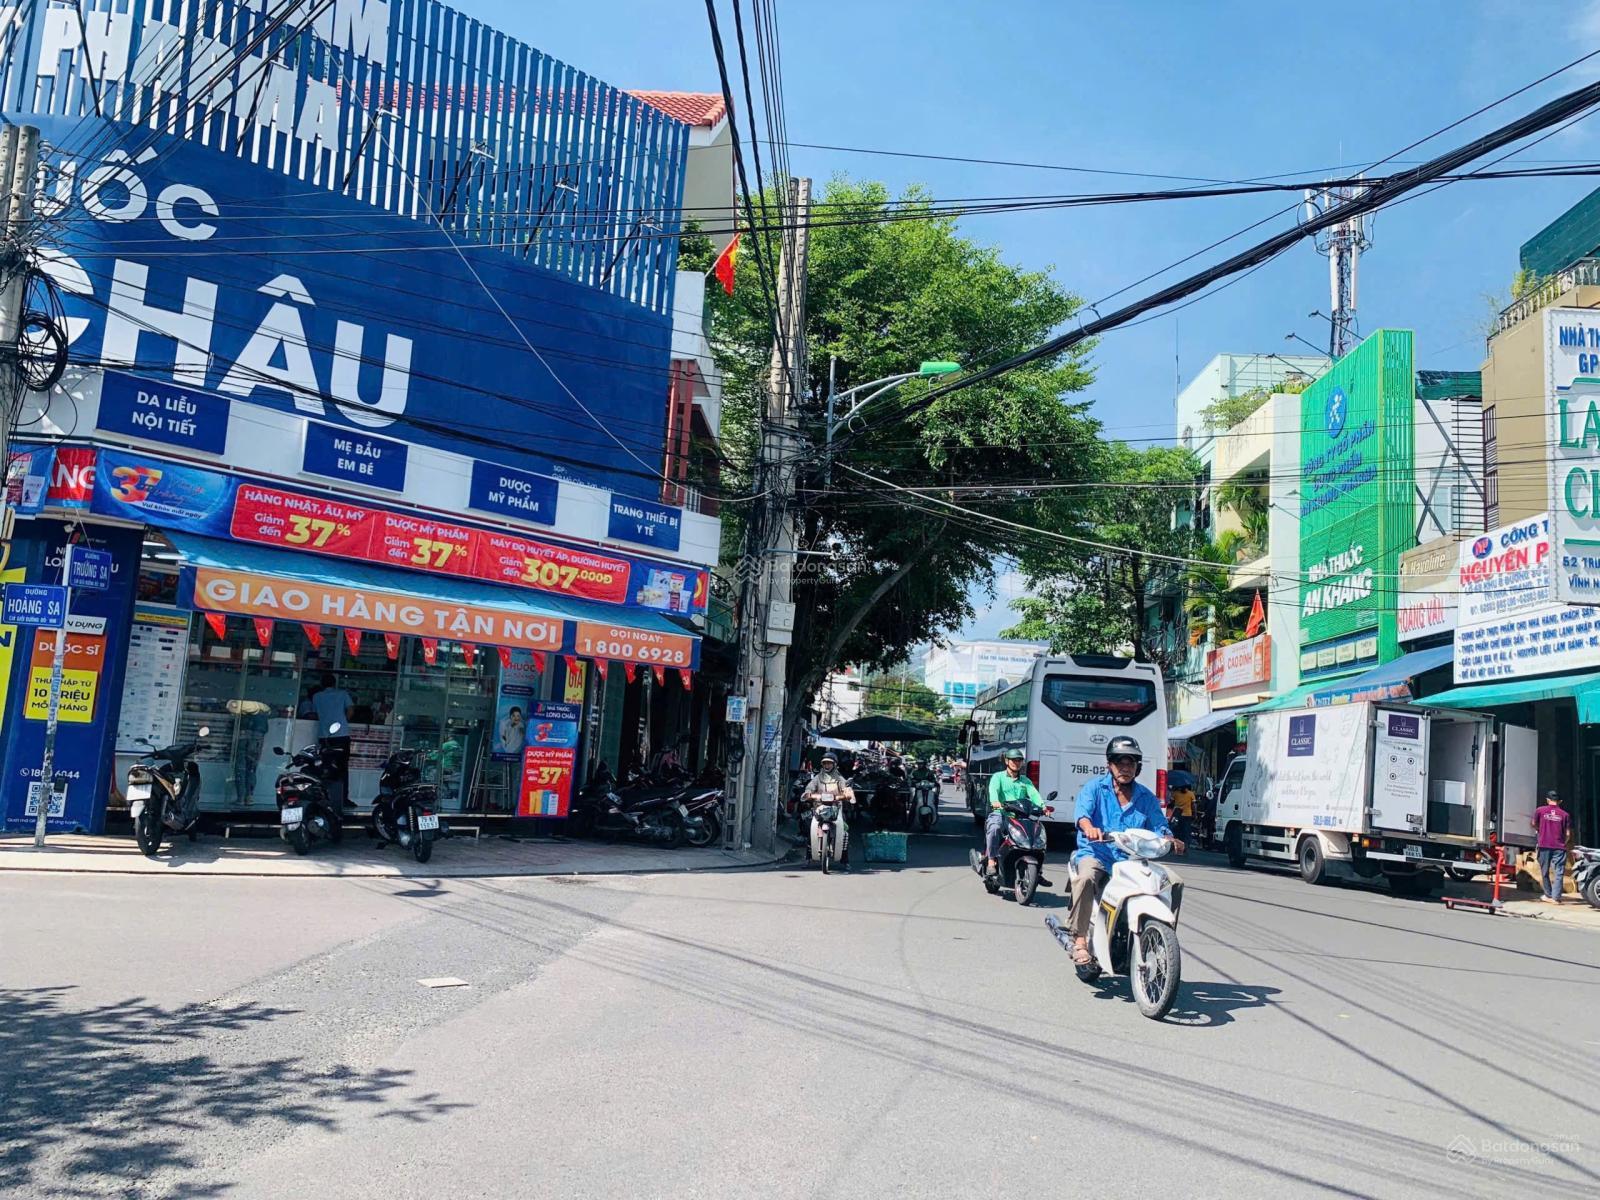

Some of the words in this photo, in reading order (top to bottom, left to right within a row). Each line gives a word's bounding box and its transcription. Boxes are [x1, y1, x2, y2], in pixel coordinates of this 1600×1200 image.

[1560, 322, 1585, 347] NHÀ
[137, 391, 160, 408] DA
[166, 391, 197, 416] LIỄU
[132, 412, 166, 432] NỘI
[168, 415, 197, 437] TIẾT
[334, 438, 351, 455] MẸ
[356, 440, 382, 460] BẦU
[337, 458, 355, 472] EM
[359, 459, 374, 475] BÉ
[111, 465, 163, 502] 37
[500, 477, 532, 494] DƯỢC
[245, 489, 282, 507] HÀNG
[285, 495, 320, 515] NHẬT,
[346, 507, 365, 521] MỸ
[489, 489, 504, 503] MỸ
[507, 492, 539, 512] PHẨM
[613, 503, 643, 520] TRANG
[646, 509, 668, 526] THIẾT
[669, 516, 679, 529] BỊ
[259, 524, 281, 538] đến
[386, 518, 417, 531] DƯỢC
[420, 522, 436, 535] MỸ
[637, 524, 642, 535] Y
[644, 524, 655, 537] TẾ
[490, 538, 510, 549] MÁY
[1500, 522, 1538, 549] CÔNG
[1329, 541, 1364, 575] THUỐC
[1563, 556, 1578, 567] 52
[73, 560, 98, 579] TRƯỜNG
[100, 565, 108, 580] SA
[1301, 587, 1321, 618] AN
[1322, 567, 1373, 610] KHANG
[8, 595, 42, 615] HOÀNG
[47, 600, 60, 616] SA
[206, 578, 311, 611] GIAO
[322, 591, 424, 626] HÀNG
[434, 604, 494, 637] TẬN
[503, 618, 557, 643] NƠI
[75, 620, 103, 631] DỤNG
[610, 628, 632, 642] GỌI
[634, 630, 664, 643] NGAY:
[87, 644, 101, 656] SĨ
[584, 638, 634, 658] 1800
[638, 643, 685, 664] 6928
[510, 661, 537, 672] HUỐC
[61, 678, 79, 687] HẬP
[34, 688, 47, 697] 10
[60, 689, 90, 703] RIỆU
[31, 699, 48, 709] MỖ
[59, 701, 88, 712] HÁNG
[1291, 736, 1312, 746] CLASSIC
[1071, 765, 1107, 776] 79B-02
